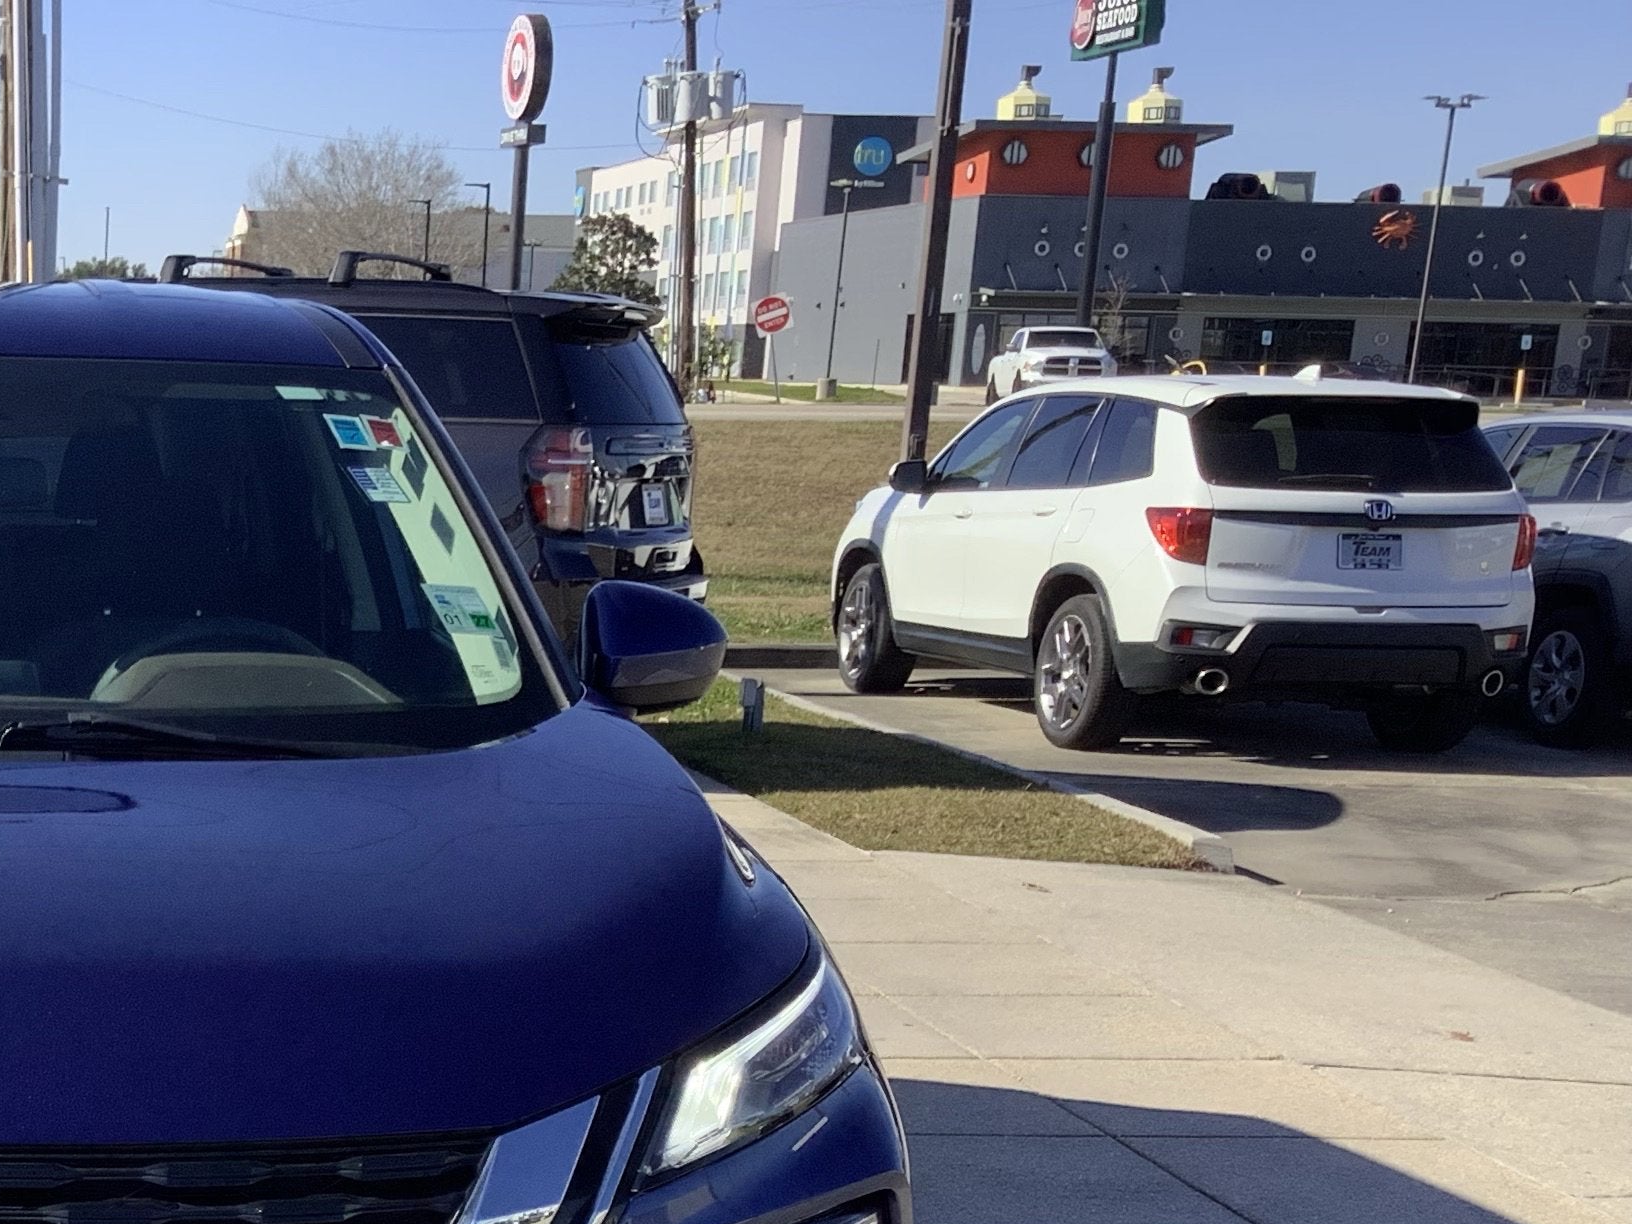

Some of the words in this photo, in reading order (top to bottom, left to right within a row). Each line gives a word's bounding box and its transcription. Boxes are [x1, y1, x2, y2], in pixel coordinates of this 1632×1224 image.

[1096, 4, 1137, 31] SEAFOOD
[855, 145, 885, 165] tru
[443, 613, 463, 625] 01
